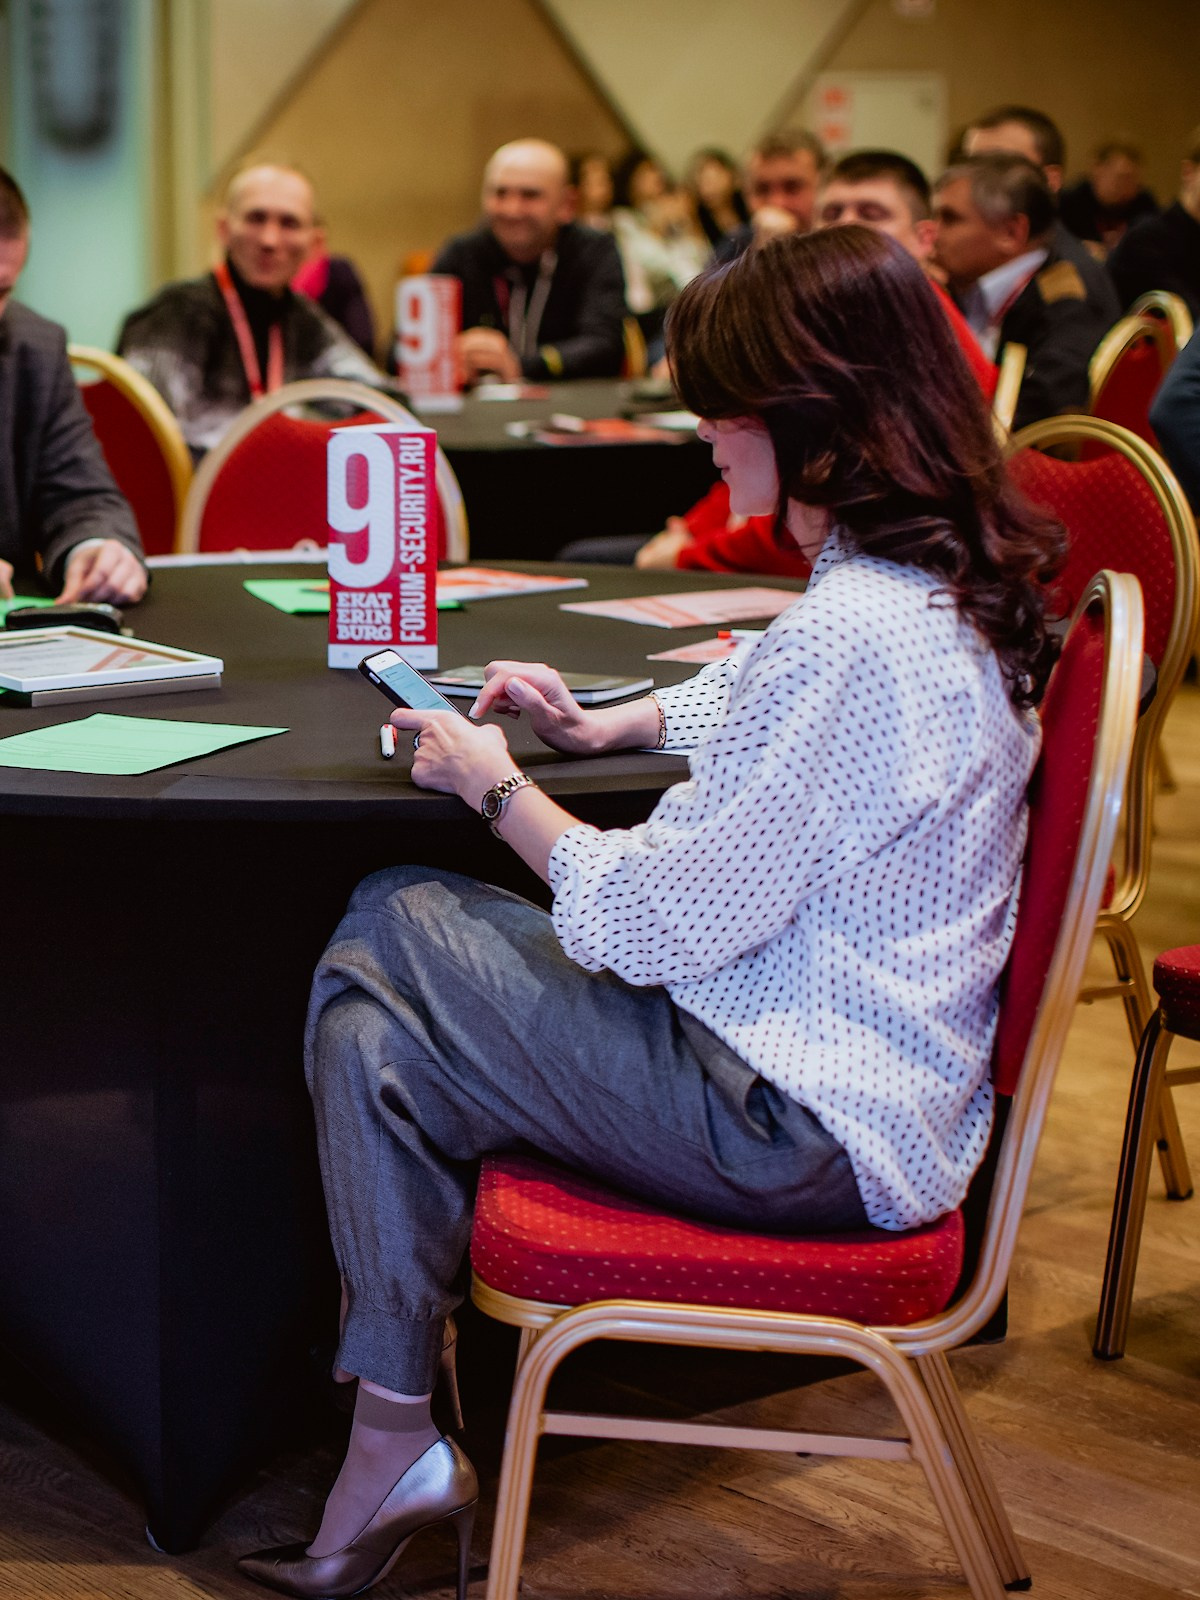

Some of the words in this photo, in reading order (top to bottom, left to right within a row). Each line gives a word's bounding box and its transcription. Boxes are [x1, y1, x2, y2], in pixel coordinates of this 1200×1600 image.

[395, 277, 437, 366] 9
[327, 432, 395, 588] 9
[399, 437, 427, 642] FORUM-SECURITY.RU
[336, 591, 393, 609] EKAT
[336, 608, 392, 626] ERIN
[336, 624, 393, 642] BURG
